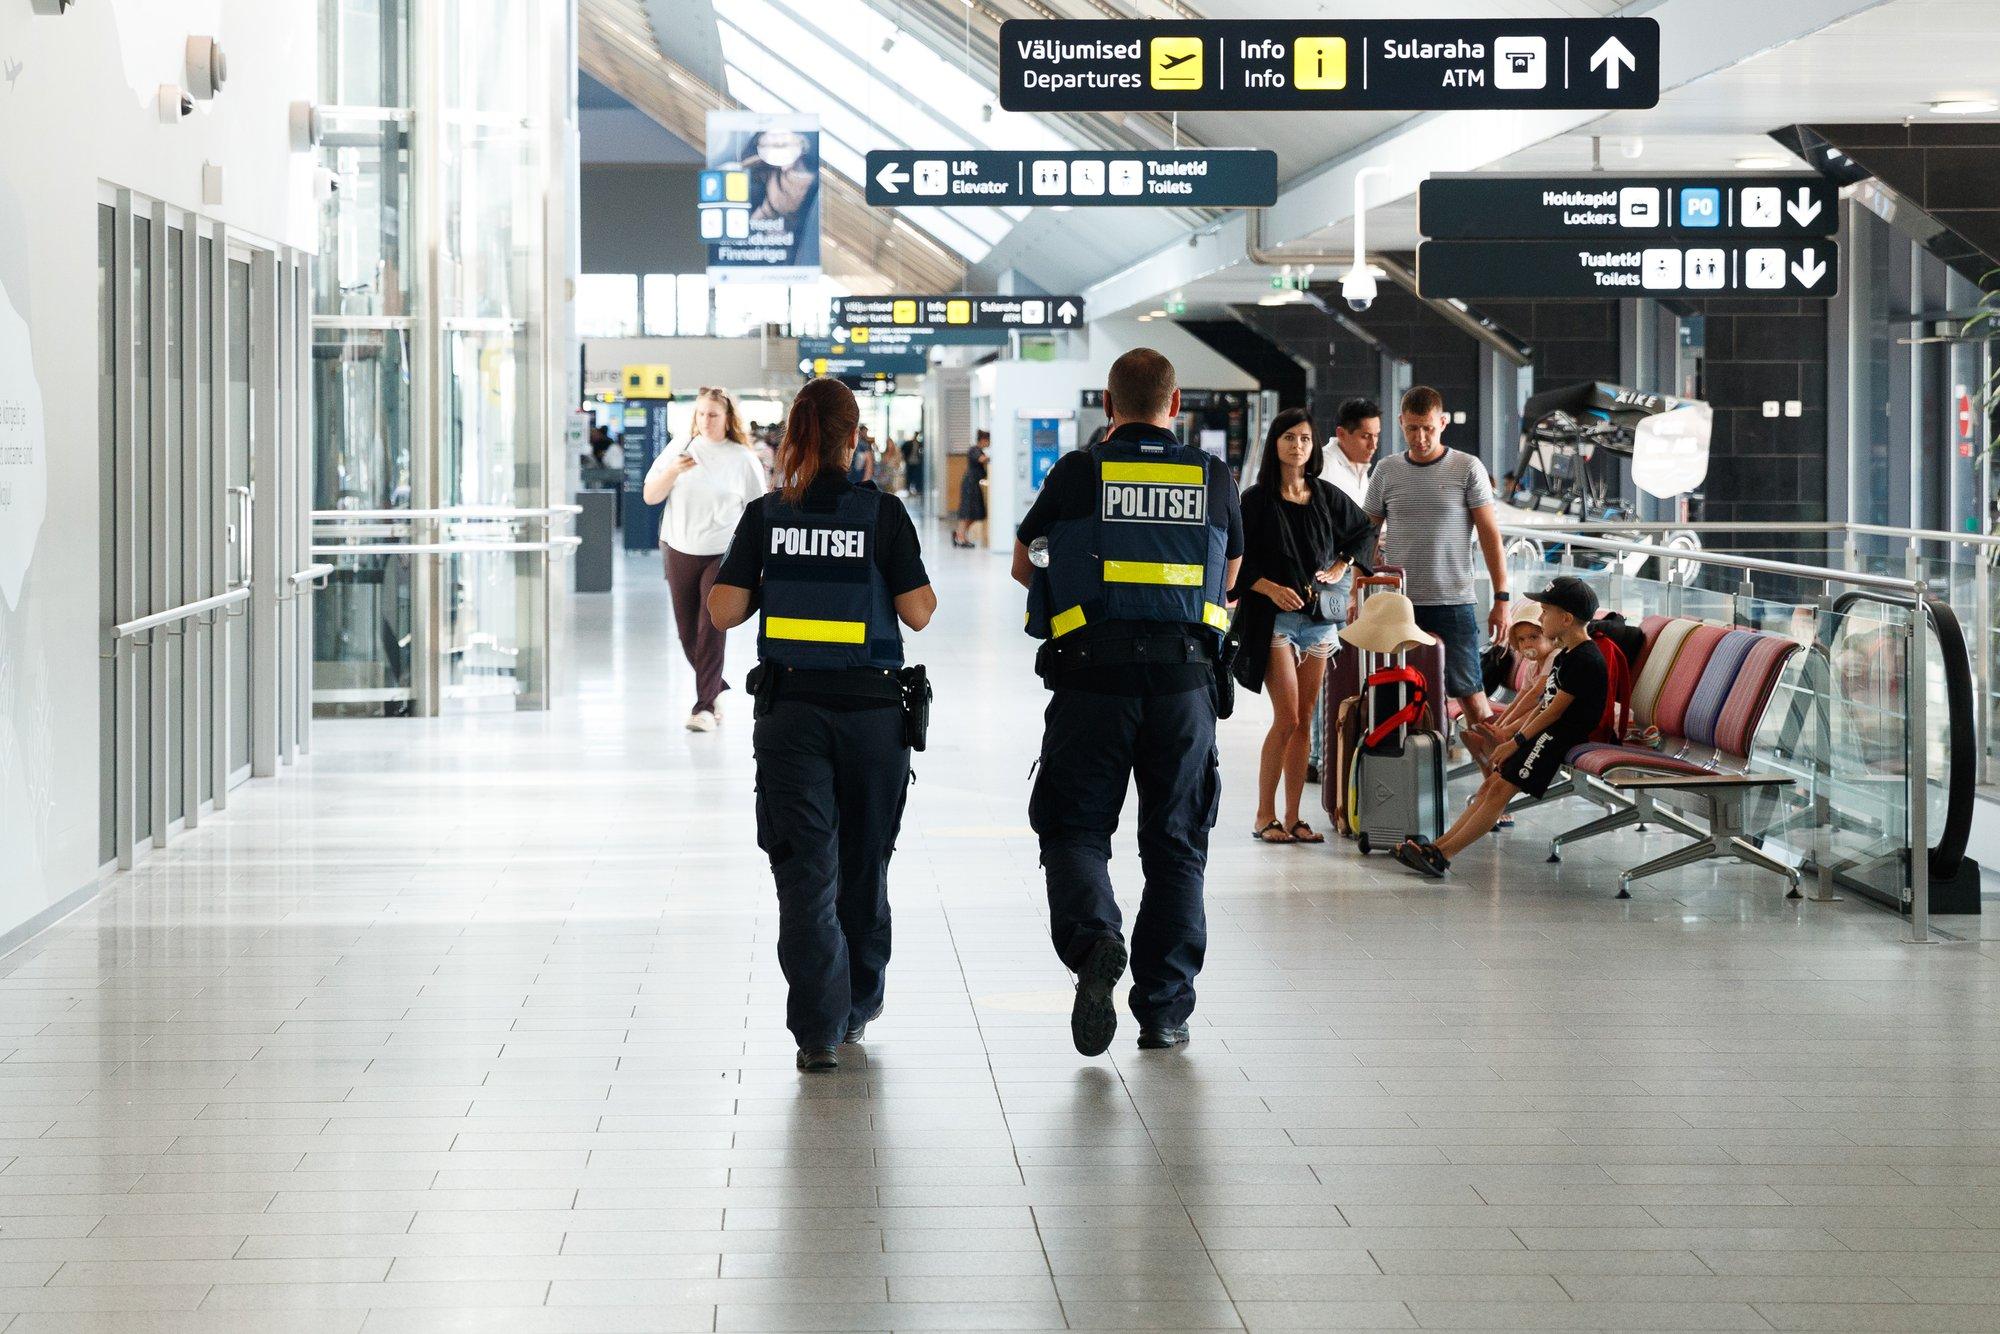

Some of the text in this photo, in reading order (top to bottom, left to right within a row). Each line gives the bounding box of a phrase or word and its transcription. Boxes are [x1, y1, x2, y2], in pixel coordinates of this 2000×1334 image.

[1017, 39, 1141, 64] Väljumised
[1240, 39, 1285, 59] Info
[1383, 39, 1485, 59] Sularaha
[1023, 69, 1142, 92] Departures
[1244, 69, 1285, 88] Info
[1441, 69, 1485, 88] ATM
[952, 160, 978, 176] Lift
[1147, 160, 1208, 176] Tualetid
[952, 179, 1009, 194] Elevator
[1147, 179, 1193, 194] Toilets
[1543, 191, 1617, 208] Hoiukapid
[1563, 211, 1617, 225] Lockers
[1579, 252, 1641, 267] Tualetid
[1594, 272, 1641, 286] Toilets
[1106, 485, 1203, 520] POLITSEI
[770, 527, 865, 558] POLITSEI
